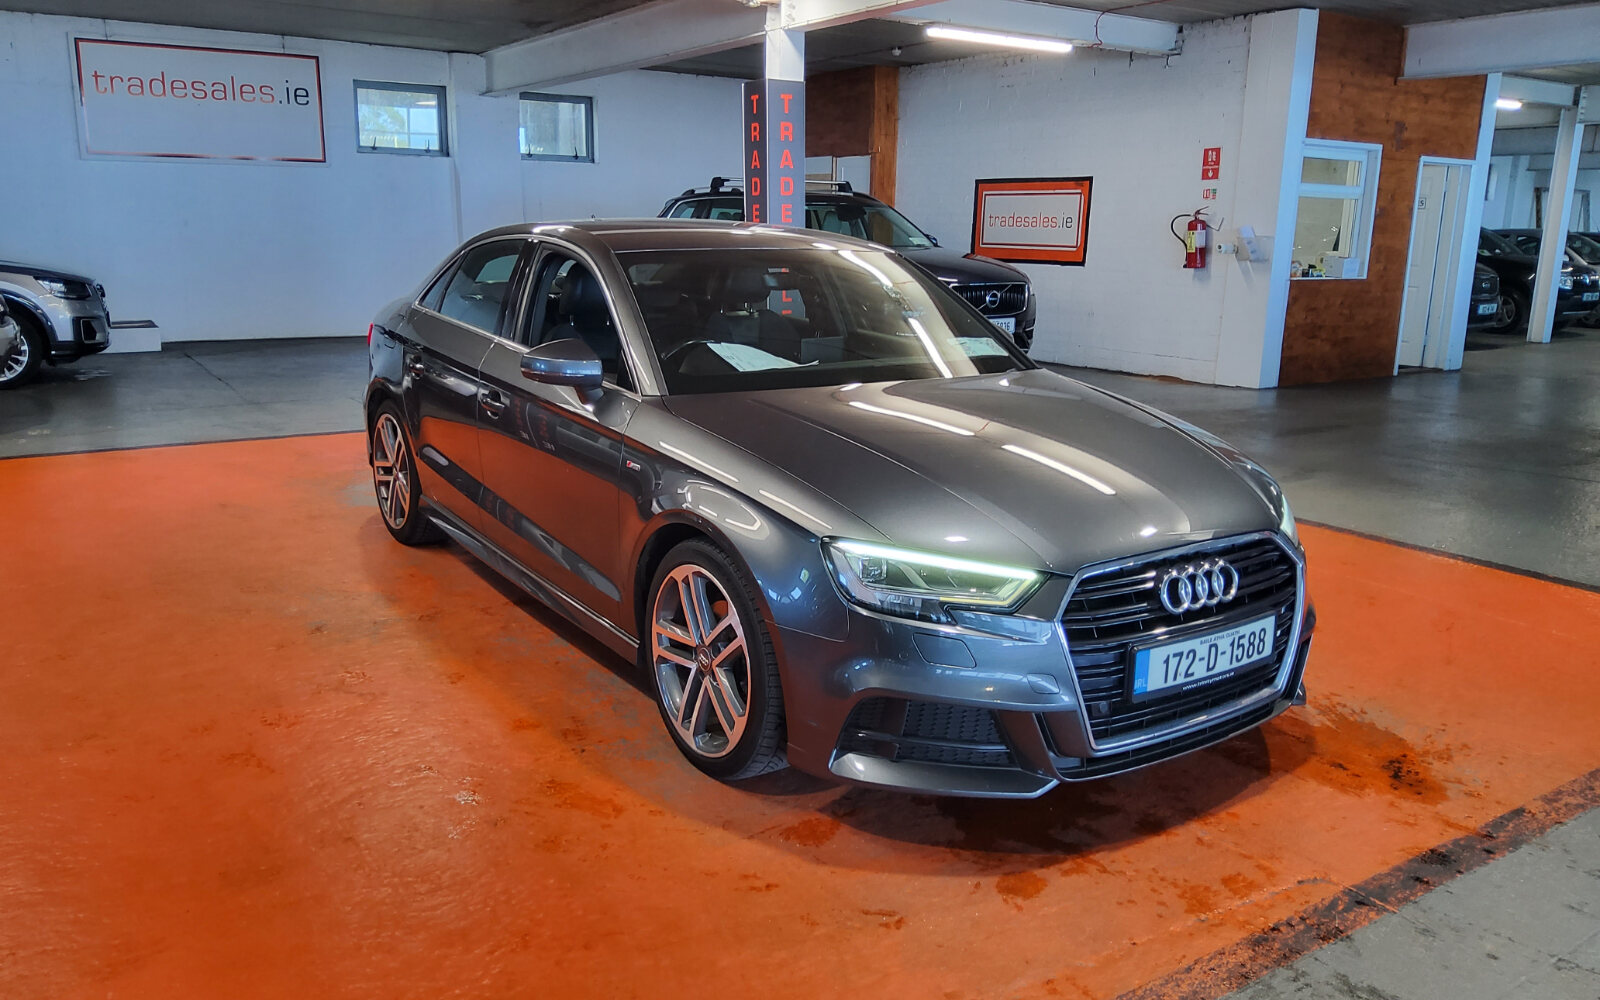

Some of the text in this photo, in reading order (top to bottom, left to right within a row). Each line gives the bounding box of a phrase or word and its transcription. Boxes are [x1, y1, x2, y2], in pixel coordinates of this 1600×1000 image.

[92, 70, 310, 106] tradesales.ie
[750, 94, 761, 223] TRADE
[779, 93, 794, 223] TRADE
[989, 211, 1073, 229] tradesales.ie
[1163, 627, 1267, 685] 172-D-1588
[1134, 677, 1147, 689] IRL
